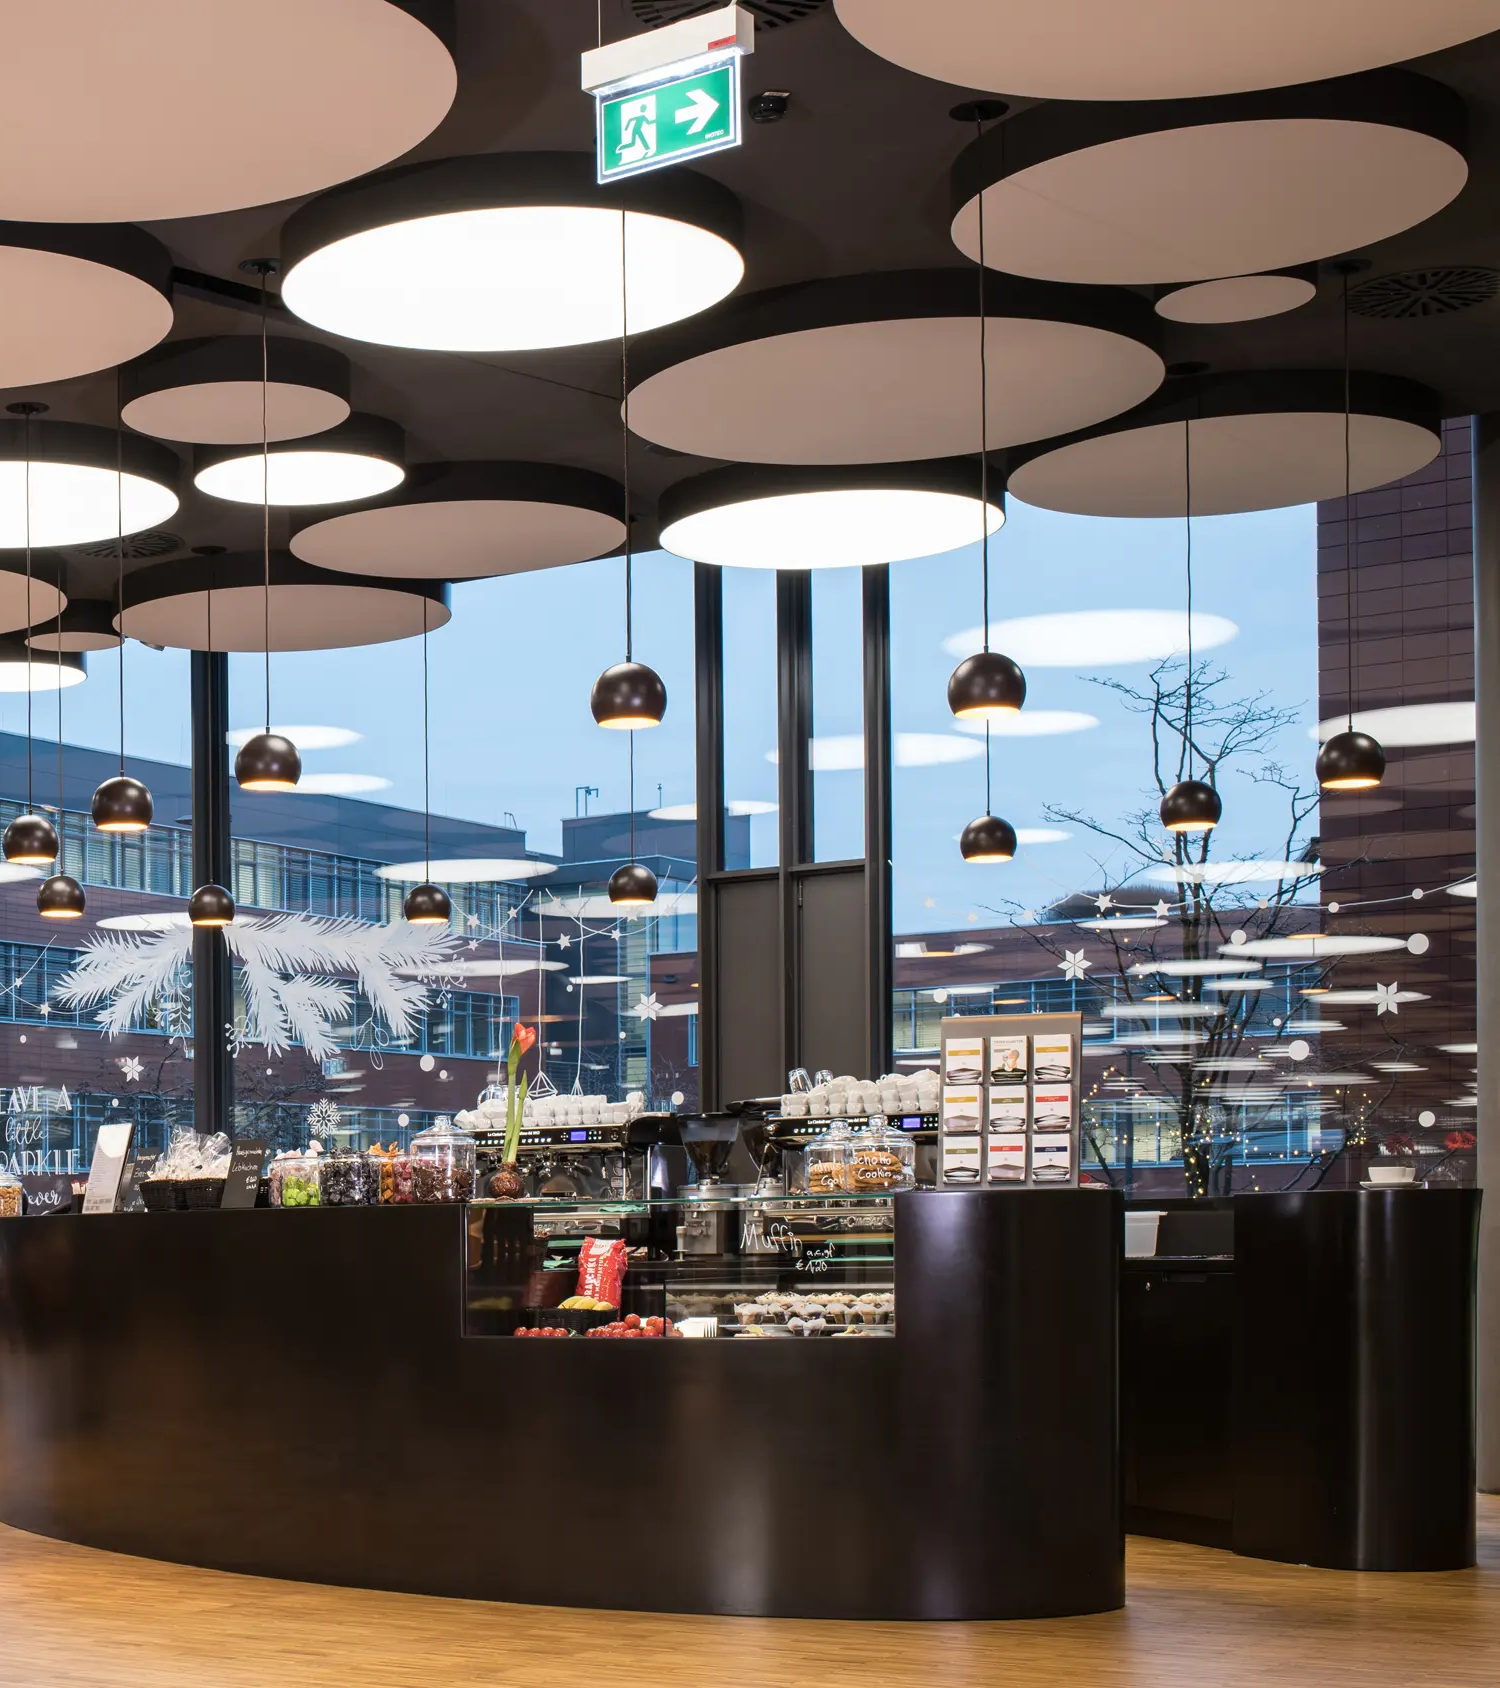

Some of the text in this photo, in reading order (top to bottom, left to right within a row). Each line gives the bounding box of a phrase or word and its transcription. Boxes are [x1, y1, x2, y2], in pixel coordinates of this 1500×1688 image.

[55, 1083, 73, 1112] A
[5, 1116, 47, 1145] little
[808, 1157, 844, 1173] Erdnus
[820, 1175, 844, 1186] Cook
[27, 1190, 62, 1206] ever
[739, 1222, 803, 1252] Muffin
